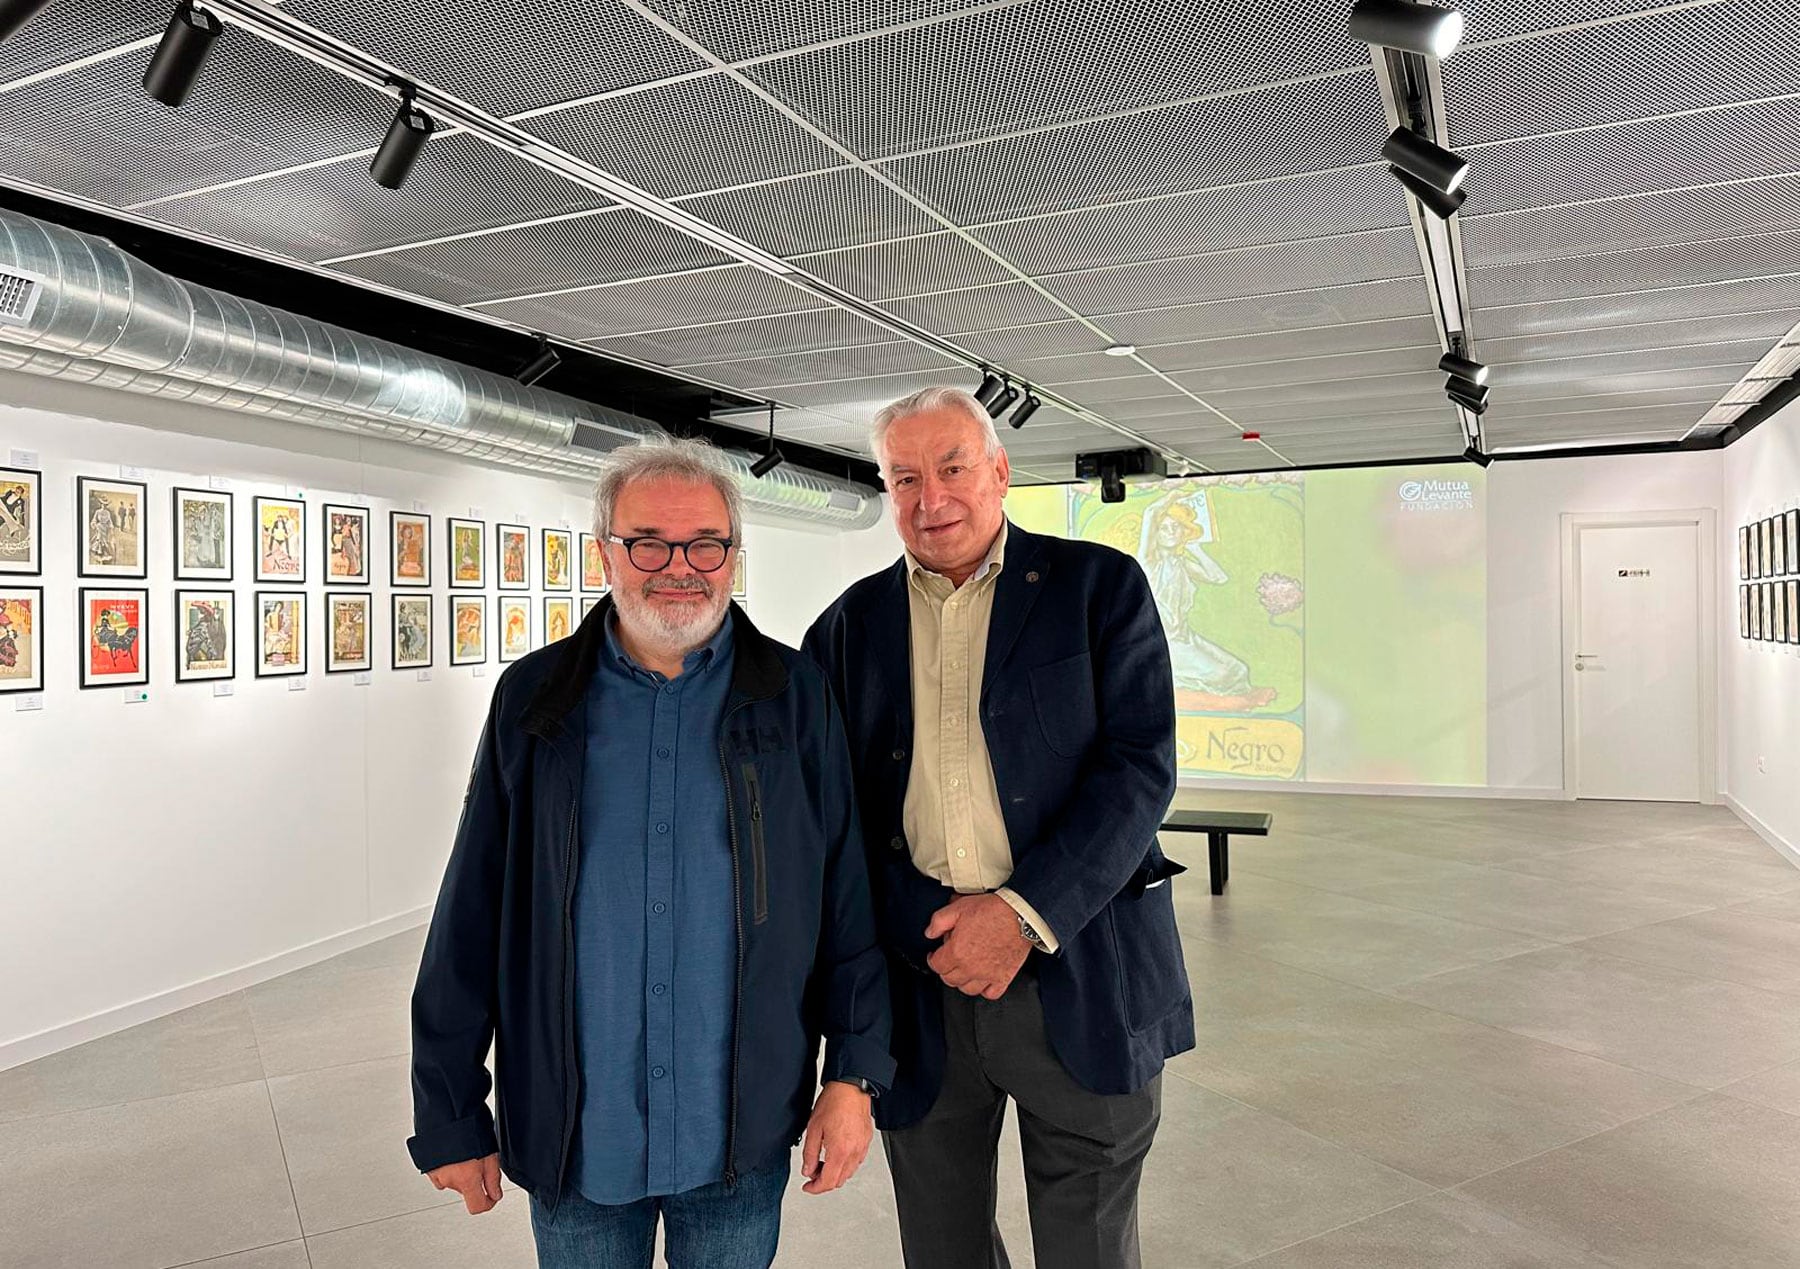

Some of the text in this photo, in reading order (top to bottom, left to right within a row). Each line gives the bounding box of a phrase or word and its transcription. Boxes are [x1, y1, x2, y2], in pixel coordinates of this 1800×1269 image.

[1423, 480, 1469, 491] Mutua
[1421, 489, 1472, 501] Levante
[1206, 726, 1285, 770] Negro
